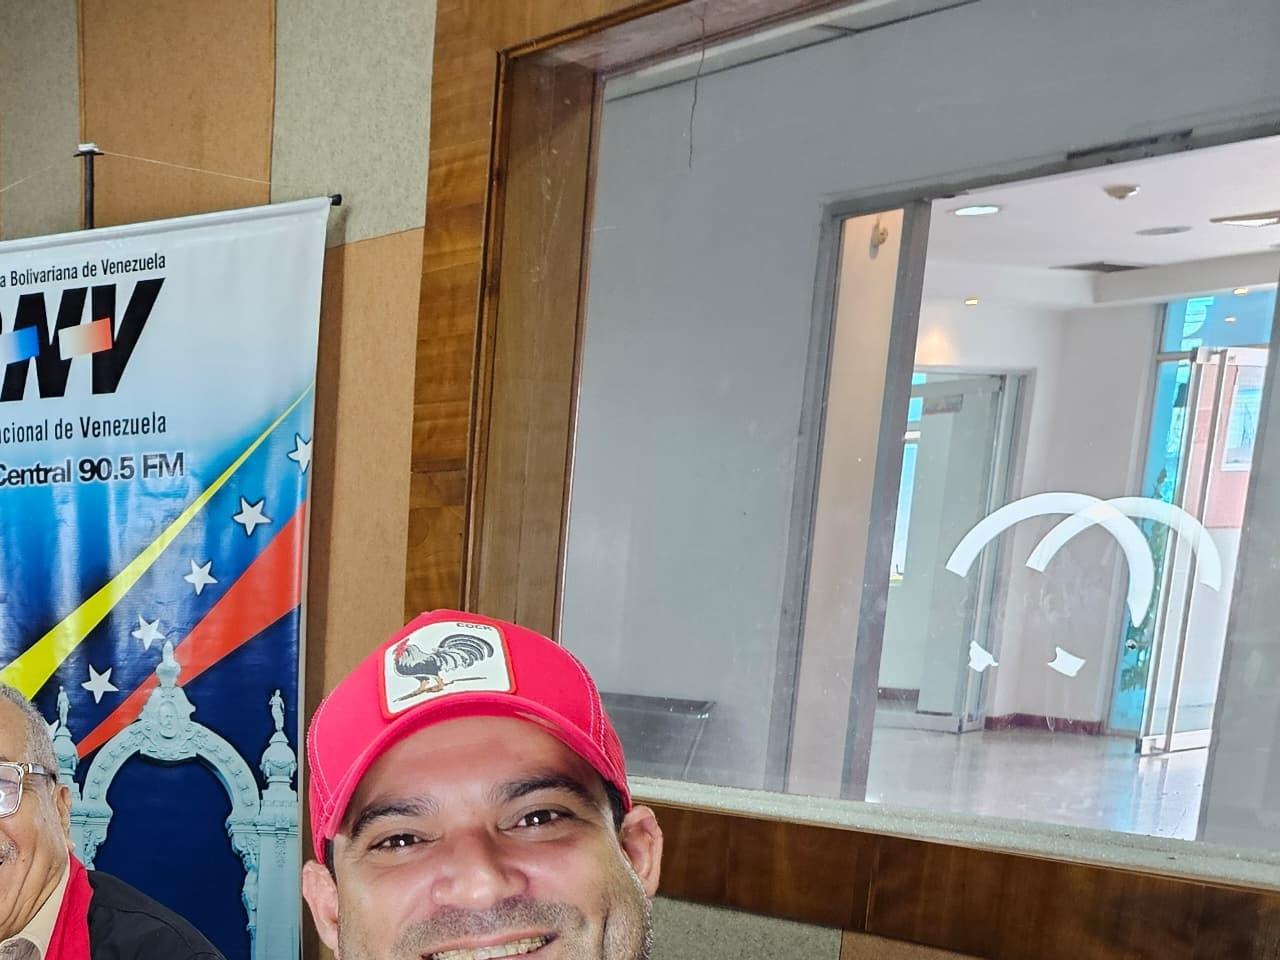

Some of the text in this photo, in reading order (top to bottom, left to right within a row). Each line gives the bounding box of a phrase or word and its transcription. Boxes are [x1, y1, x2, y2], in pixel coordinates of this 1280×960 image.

[10, 265, 78, 287] Bolivariana
[82, 261, 98, 278] de
[101, 253, 166, 276] Venezuela
[54, 417, 74, 440] de
[81, 411, 167, 438] Venezuela
[78, 455, 135, 482] 90.5
[142, 452, 185, 479] FM
[455, 622, 493, 632] COCK
